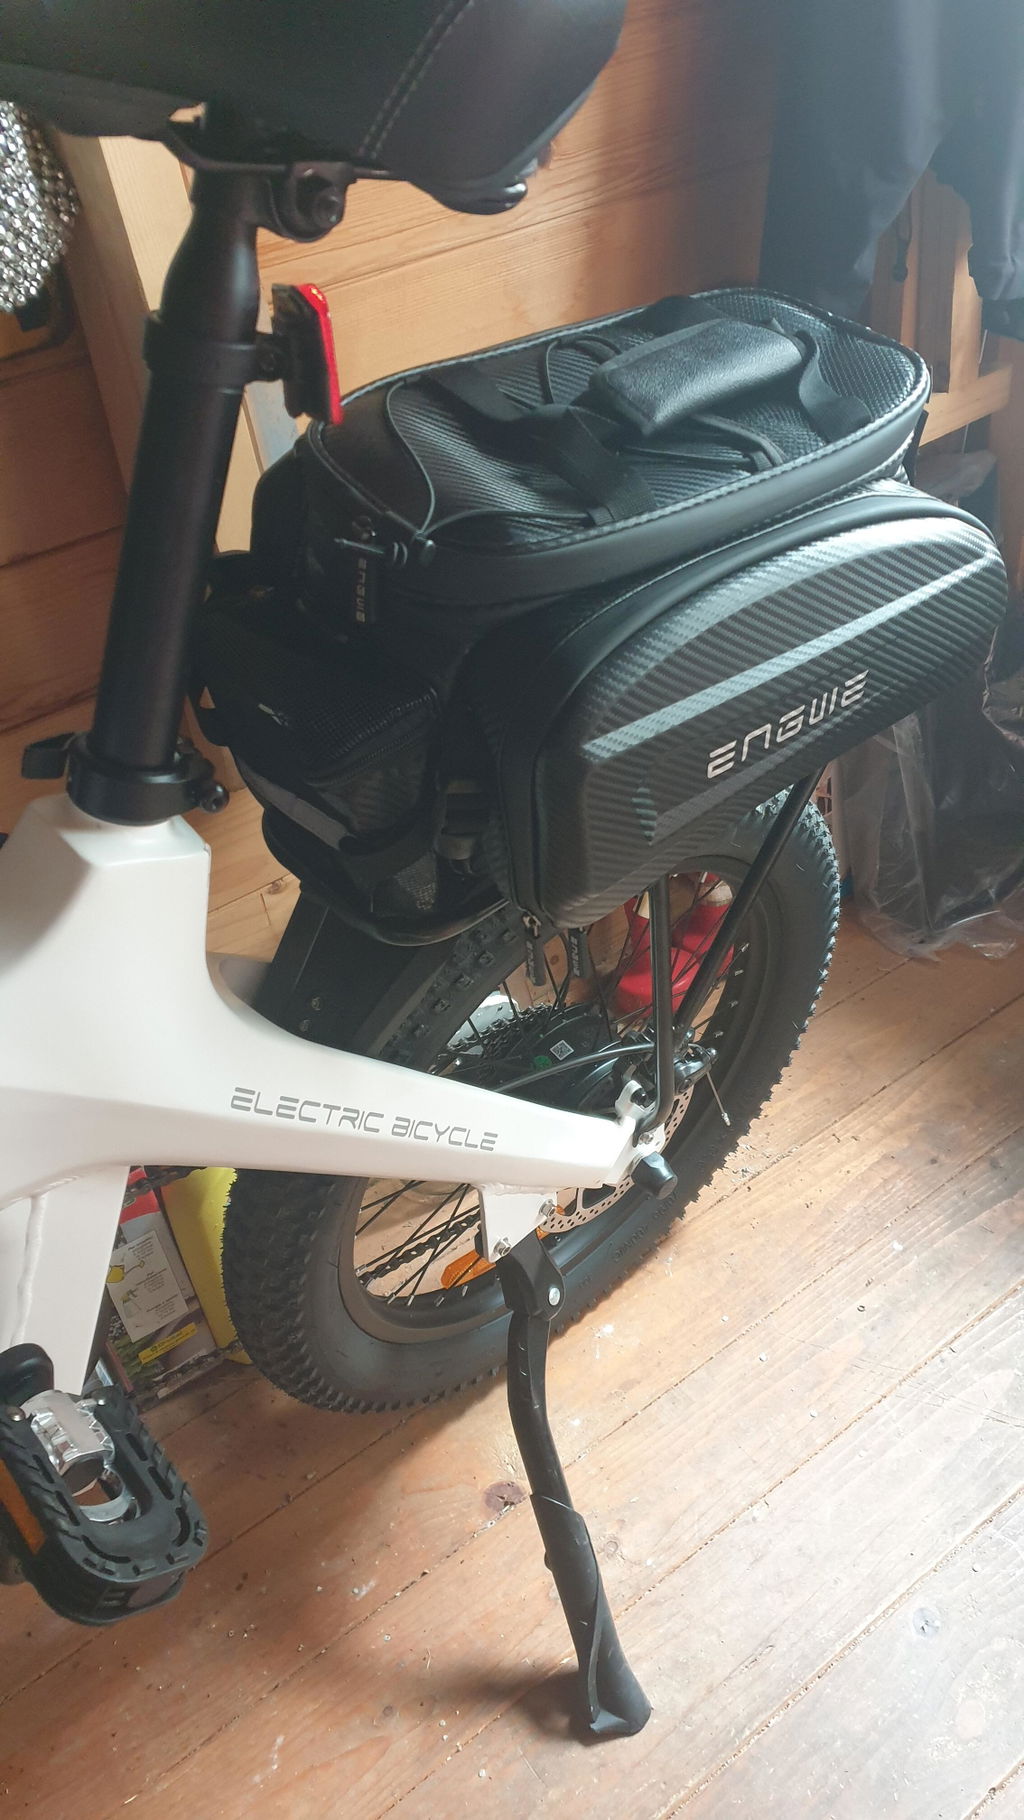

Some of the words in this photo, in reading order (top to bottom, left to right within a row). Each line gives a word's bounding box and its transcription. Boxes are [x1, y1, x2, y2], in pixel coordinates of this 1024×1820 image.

[707, 669, 869, 779] ENGWE
[230, 1087, 385, 1133] ELECTRIC
[391, 1116, 499, 1151] BICYCLE
